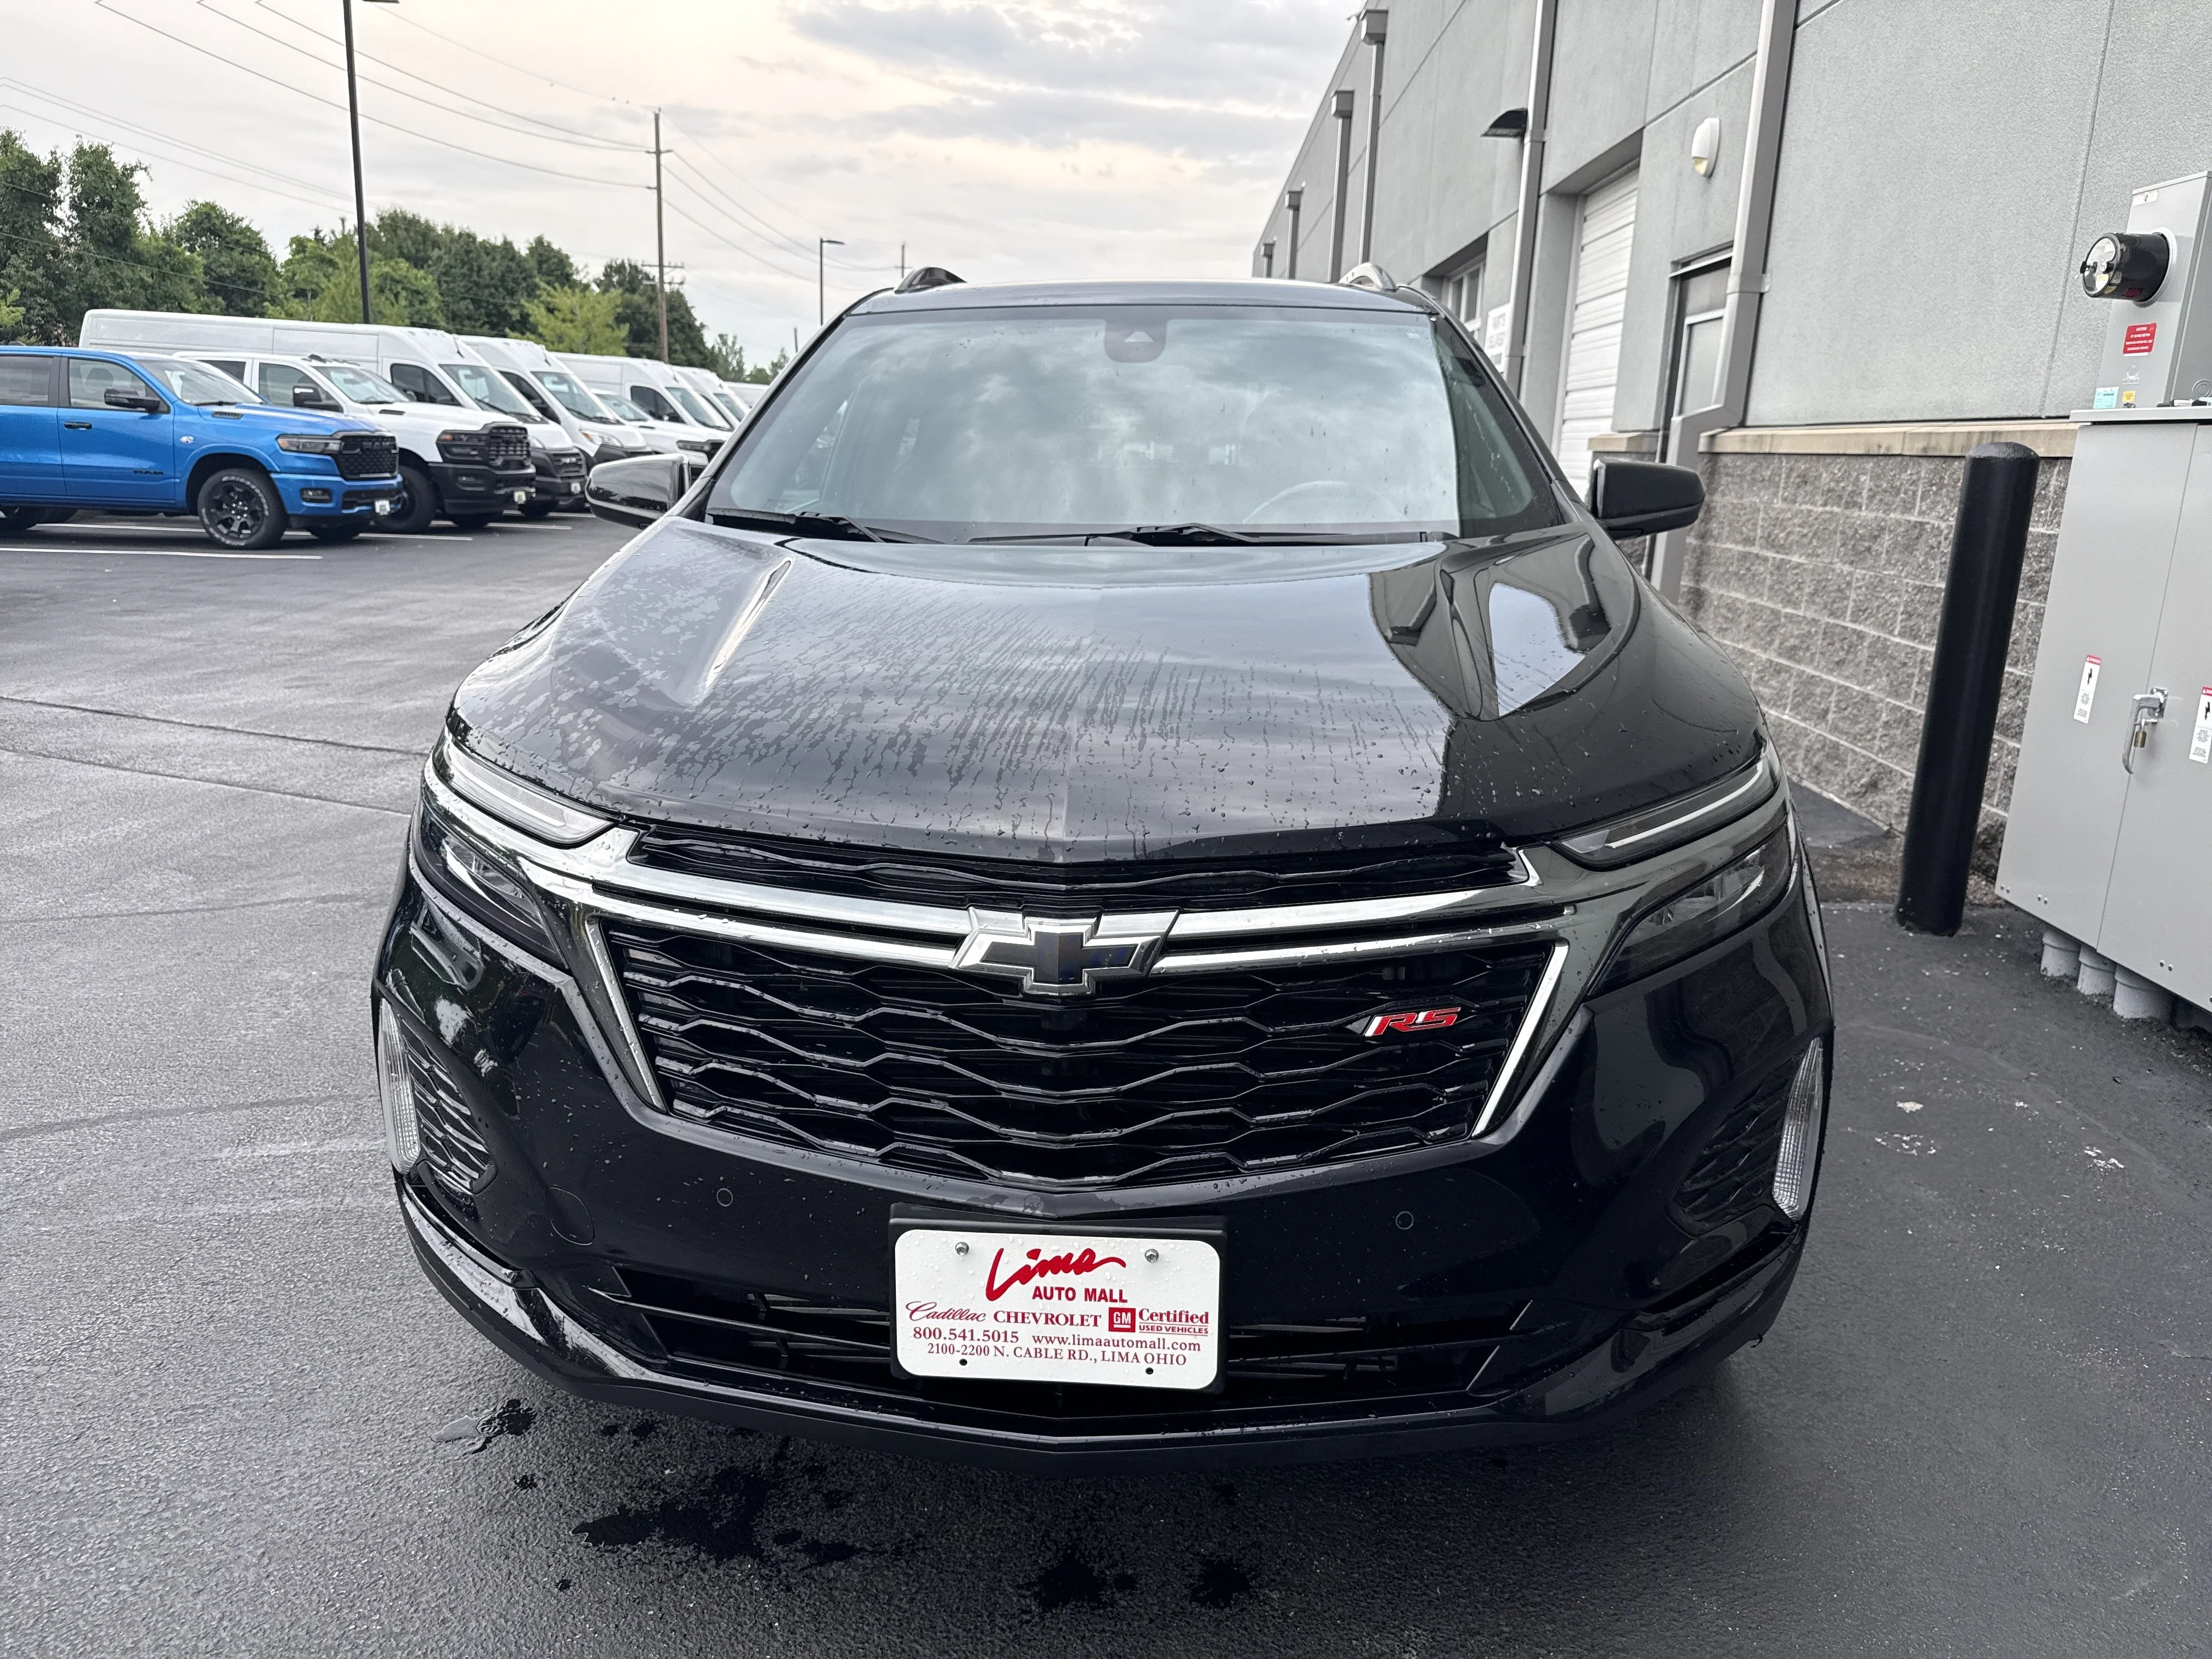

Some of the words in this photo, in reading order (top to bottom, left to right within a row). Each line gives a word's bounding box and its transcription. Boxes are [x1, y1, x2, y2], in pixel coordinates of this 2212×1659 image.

[1364, 1007, 1462, 1037] RS
[985, 1248, 1126, 1301] Lima
[1032, 1285, 1076, 1302] AUTO
[1084, 1287, 1128, 1304] MALL
[905, 1301, 986, 1322] Cadillac
[994, 1310, 1102, 1327] CHEVROLET
[1138, 1308, 1209, 1324] Certified
[913, 1327, 1019, 1343] 800.541.5015
[1032, 1334, 1201, 1351] www.limaautomall.com
[1165, 1326, 1209, 1334] VEHICLES
[927, 1342, 990, 1356] 2100-2200
[993, 1345, 1009, 1357] N.
[1013, 1346, 1064, 1359] CABLE
[1067, 1349, 1097, 1363] RD.,
[1101, 1350, 1141, 1363] LIMA
[1144, 1352, 1187, 1365] OHIO
